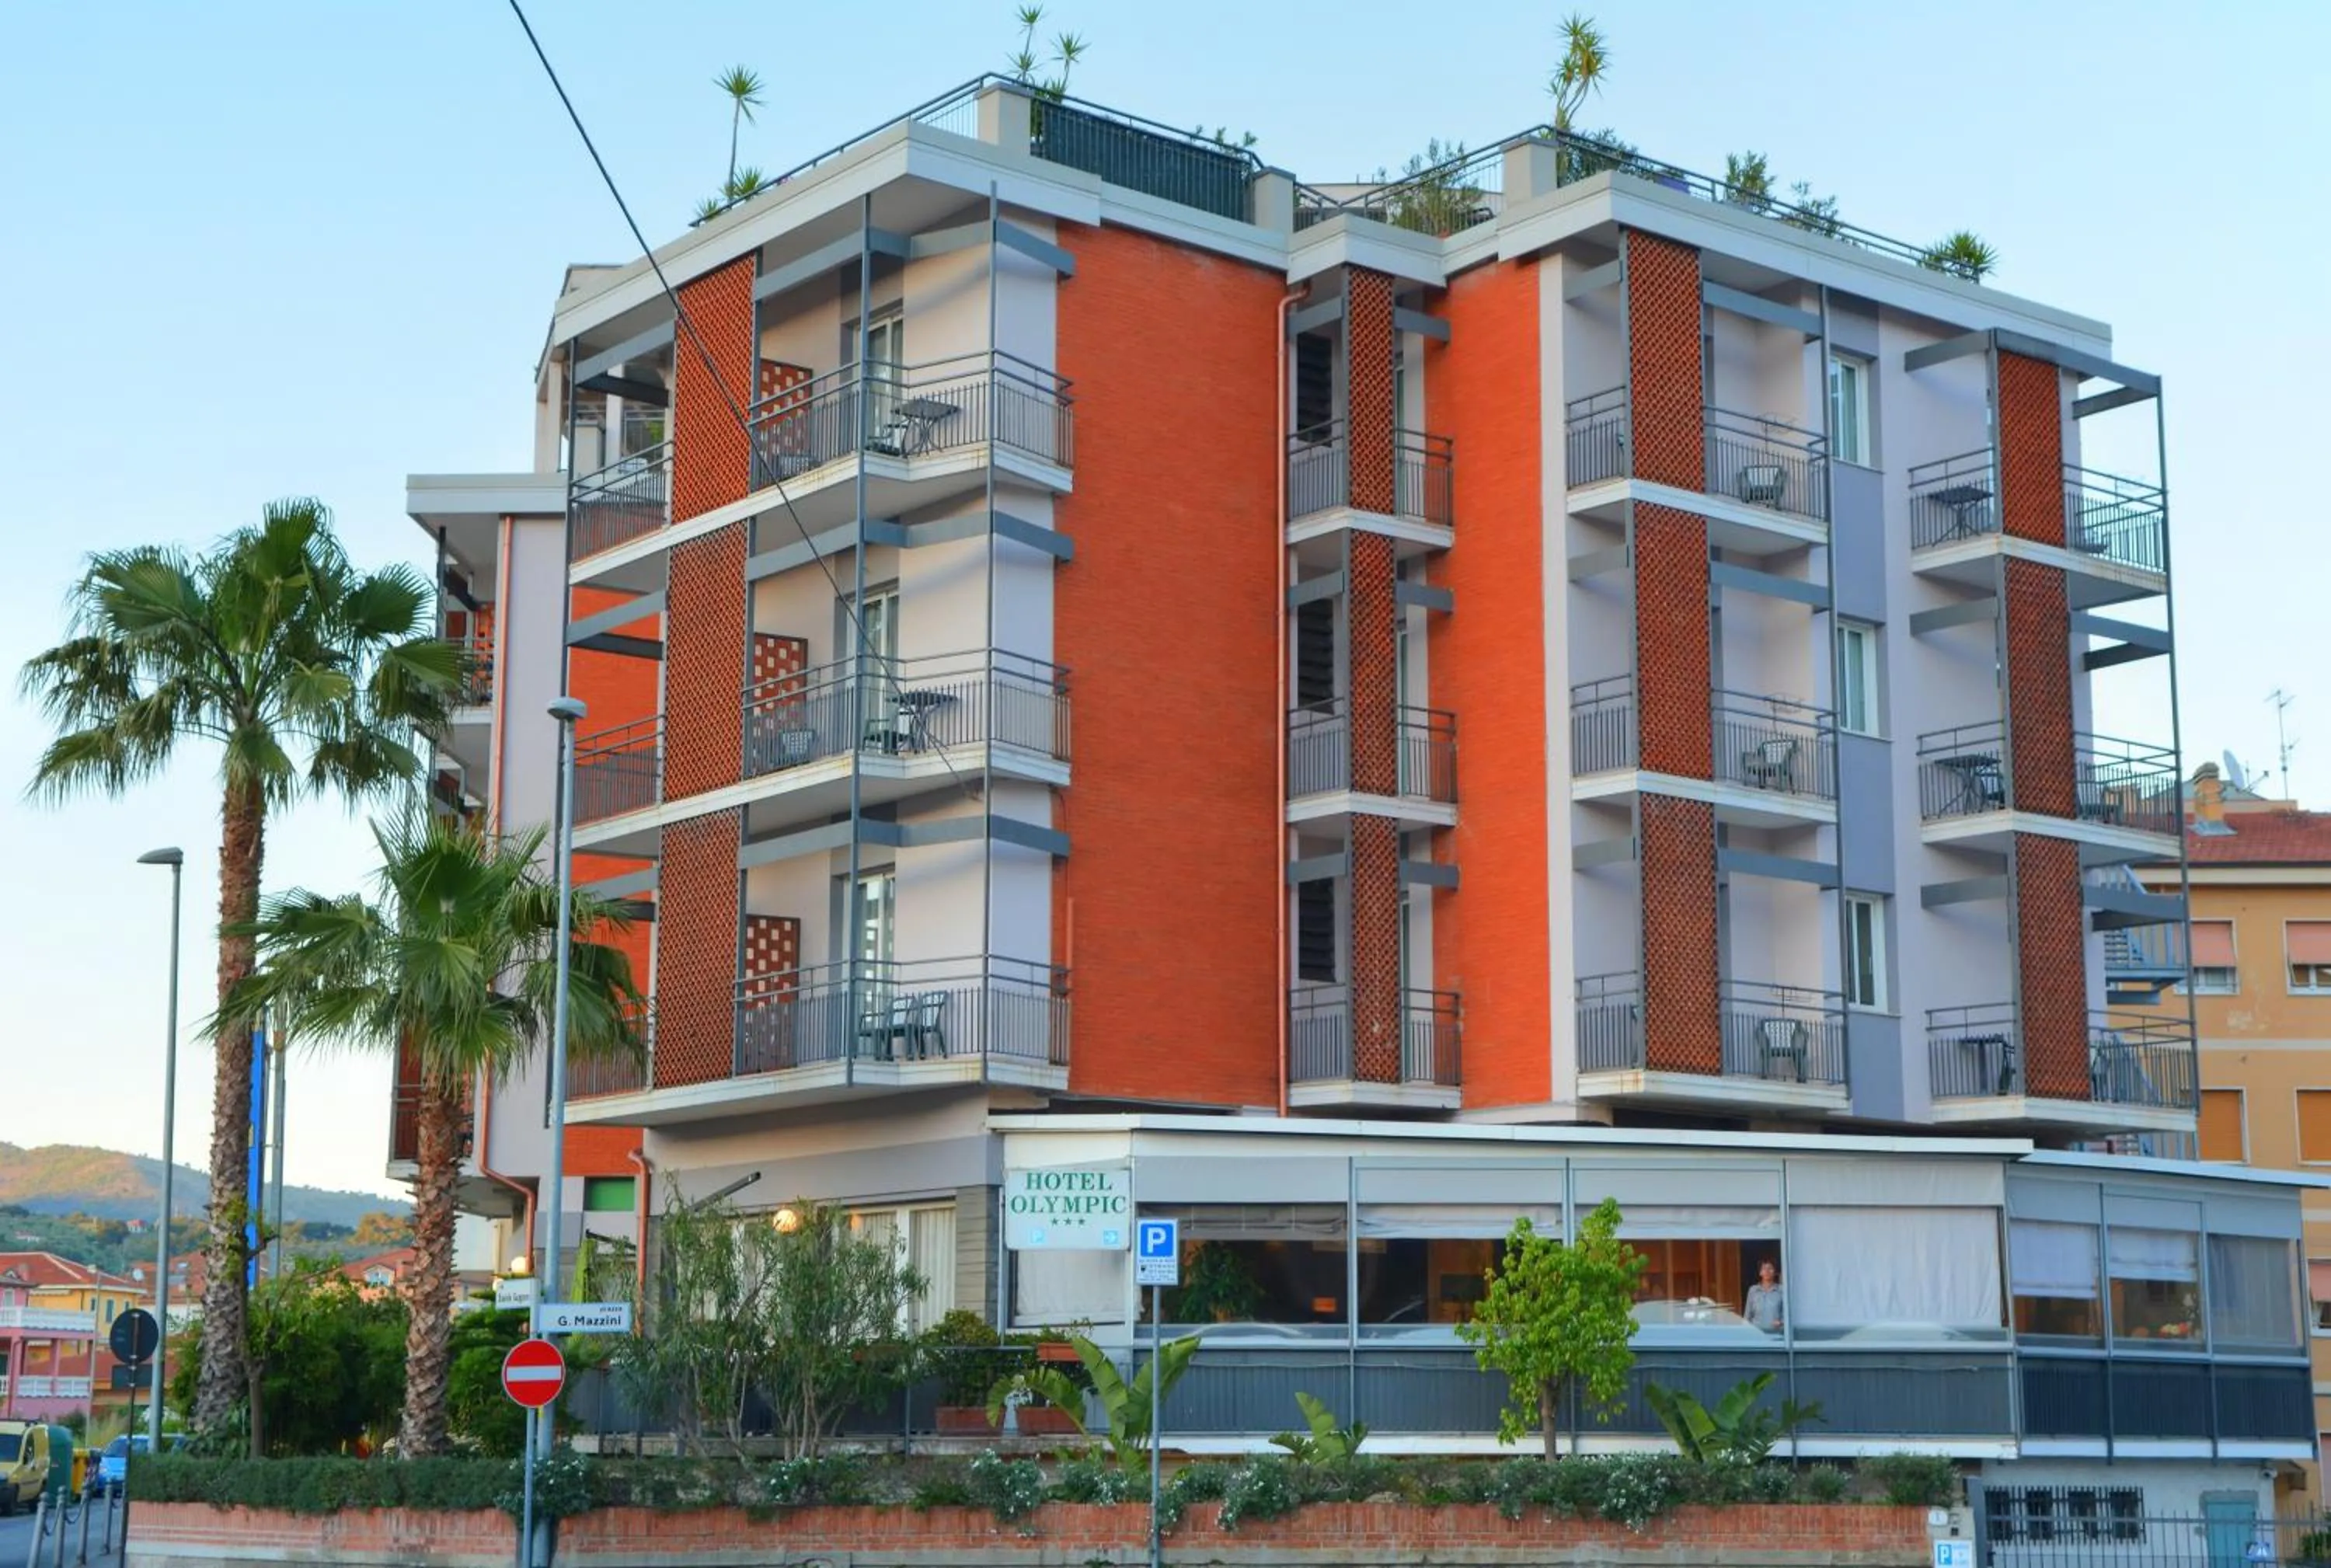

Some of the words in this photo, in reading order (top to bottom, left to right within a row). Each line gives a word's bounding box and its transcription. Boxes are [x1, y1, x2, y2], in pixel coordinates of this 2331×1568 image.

[1026, 1173, 1113, 1190] HOTEL
[1011, 1196, 1127, 1214] OLYMPIC
[1147, 1227, 1166, 1253] P
[558, 1315, 572, 1326] G.
[573, 1315, 621, 1326] Mazzini
[1939, 1545, 1949, 1563] P
